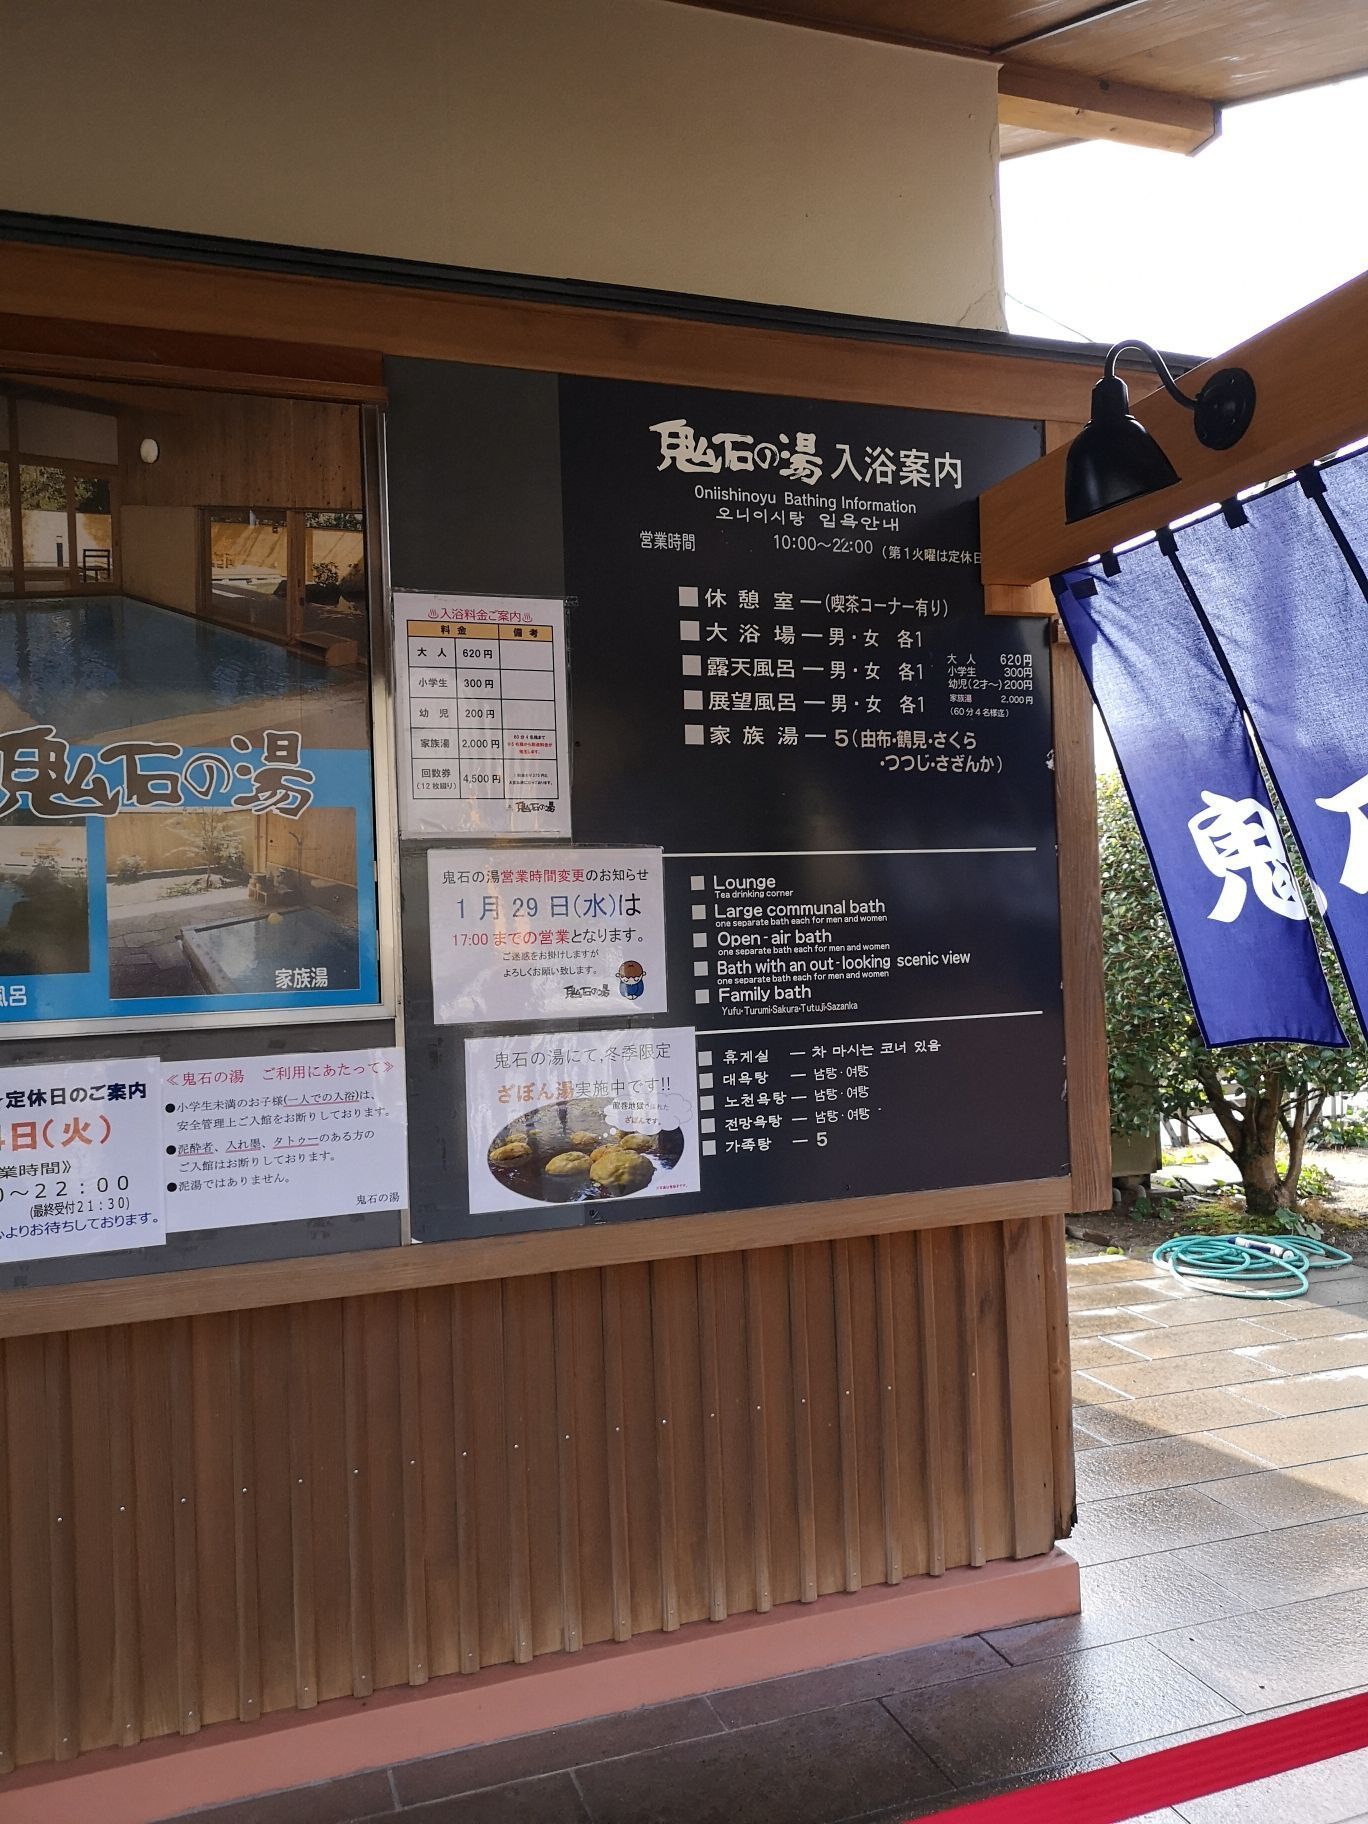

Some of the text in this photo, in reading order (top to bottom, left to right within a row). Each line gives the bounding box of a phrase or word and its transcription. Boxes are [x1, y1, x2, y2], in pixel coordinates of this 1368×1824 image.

[649, 419, 963, 489] 鬼石の湯 入浴案内
[784, 491, 837, 511] Bathing
[841, 495, 917, 515] Information
[716, 507, 900, 532] 오니이시탕 입욕안내
[639, 530, 695, 552] 営業時間
[440, 607, 521, 623] 入浴料金ご案内
[897, 629, 922, 649] 各1
[707, 656, 795, 679] 露天風呂
[899, 662, 924, 681] 各1
[1000, 654, 1033, 667] 620円
[947, 665, 1033, 678] 小学生 300円
[418, 677, 448, 688] 小学生
[1004, 680, 1033, 691] 200円
[708, 691, 797, 713] 展望風呂
[900, 695, 925, 714] 各1
[420, 738, 450, 749] 家族湯
[421, 768, 452, 778] 回数券
[442, 868, 649, 885] 鬼石の湯営業時間変更のお知らせ
[713, 875, 776, 890] Lounge
[715, 889, 794, 899] Tea drinking corner
[715, 899, 886, 919] Large communal bath
[715, 914, 887, 928] one separate bath each for men and women
[795, 928, 832, 944] bath
[503, 949, 599, 961] ご迷惑をお掛けしますが
[718, 942, 890, 956] one separate bath each for men and women
[503, 966, 598, 978] よろしくお願い致します。
[717, 960, 752, 976] Bath
[755, 957, 787, 974] with
[789, 959, 807, 972] an
[896, 951, 939, 967] scenic
[942, 951, 971, 965] view
[275, 967, 328, 988] 家族湯
[717, 970, 889, 985] one separate bath each for men and women
[718, 984, 812, 1003] Family bath
[723, 1039, 941, 1065] 휴게실 차 마시는 코너 있음
[723, 1071, 769, 1086] 대욕탕
[0, 1081, 147, 1109] 定休日のご案内
[724, 1091, 787, 1108] 노천욕탕
[177, 1107, 391, 1132] 安全管理上ご入館をお断りしております。
[724, 1114, 783, 1132] 전망욕탕
[725, 1132, 828, 1153] 가족탕 5
[179, 1150, 336, 1173] ご入館はお断りしております。
[355, 1191, 400, 1206] 鬼石の湯
[0, 1211, 158, 1240] よりお待ちしております。
